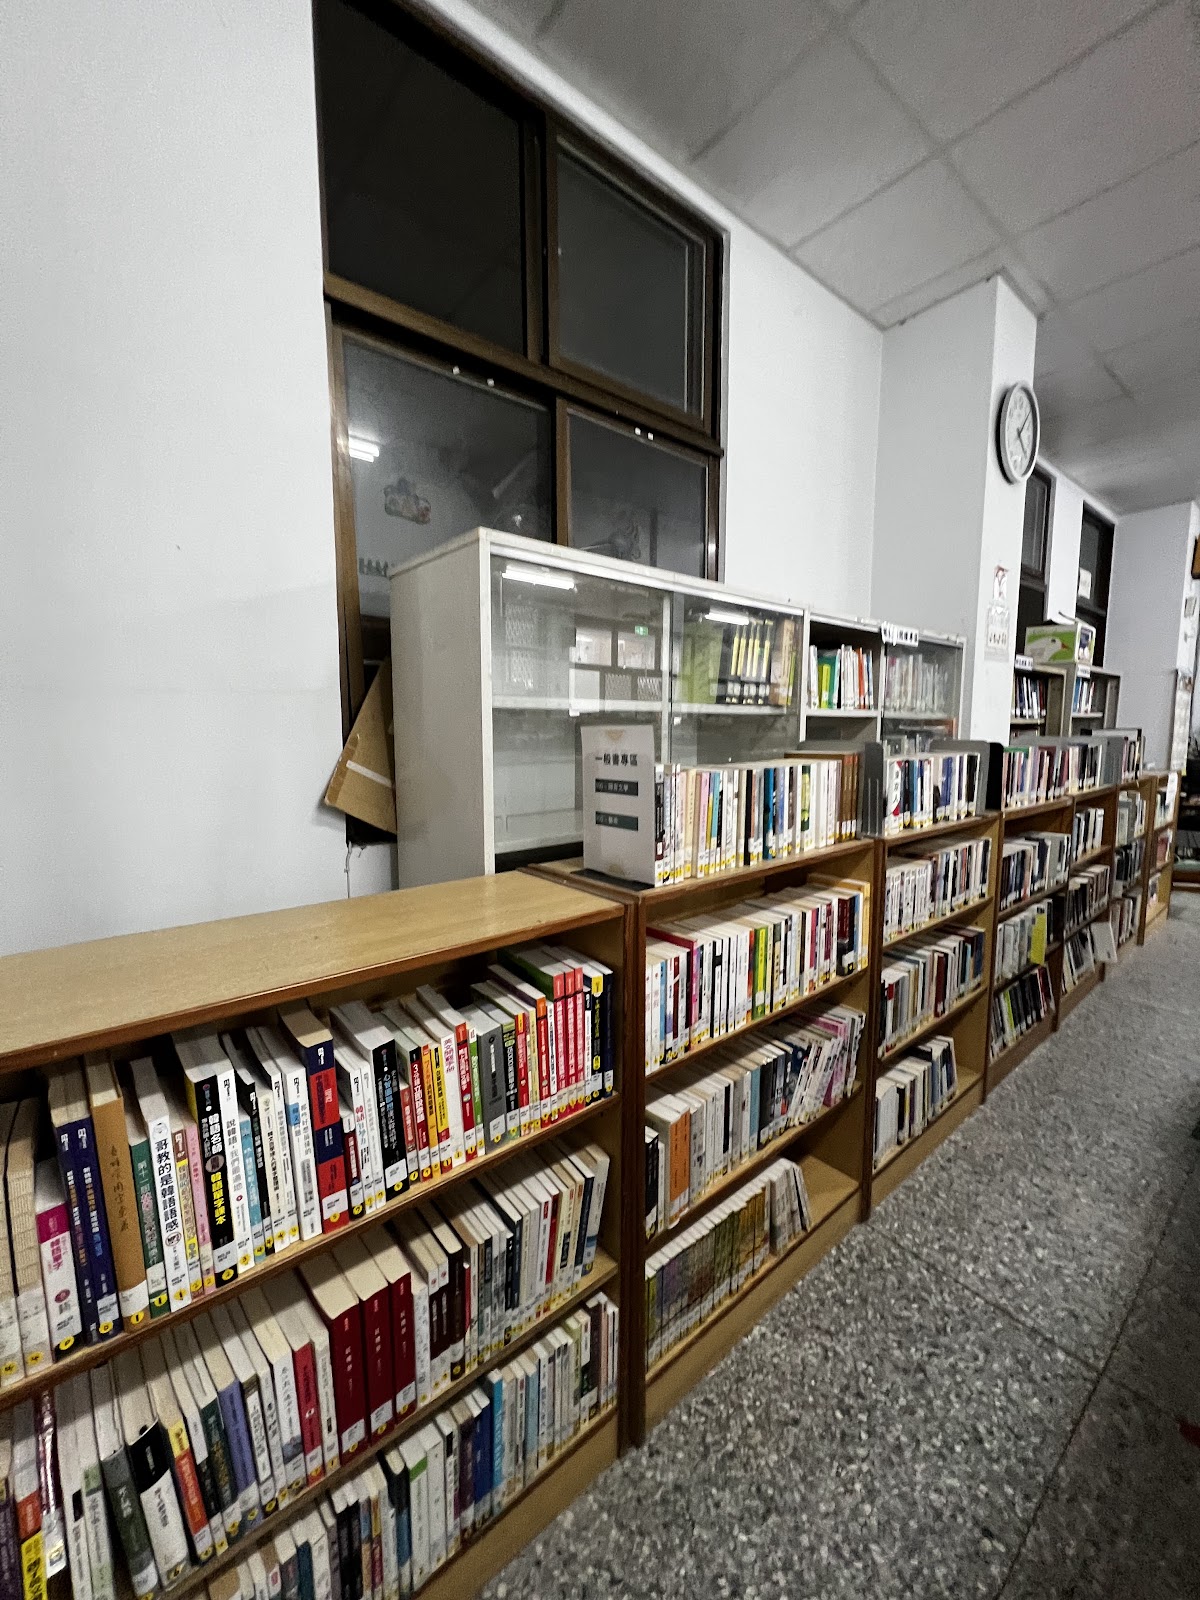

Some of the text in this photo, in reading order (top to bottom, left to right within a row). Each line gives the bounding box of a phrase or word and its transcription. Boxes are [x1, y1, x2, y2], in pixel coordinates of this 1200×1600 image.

[595, 752, 638, 766] 一般書專區
